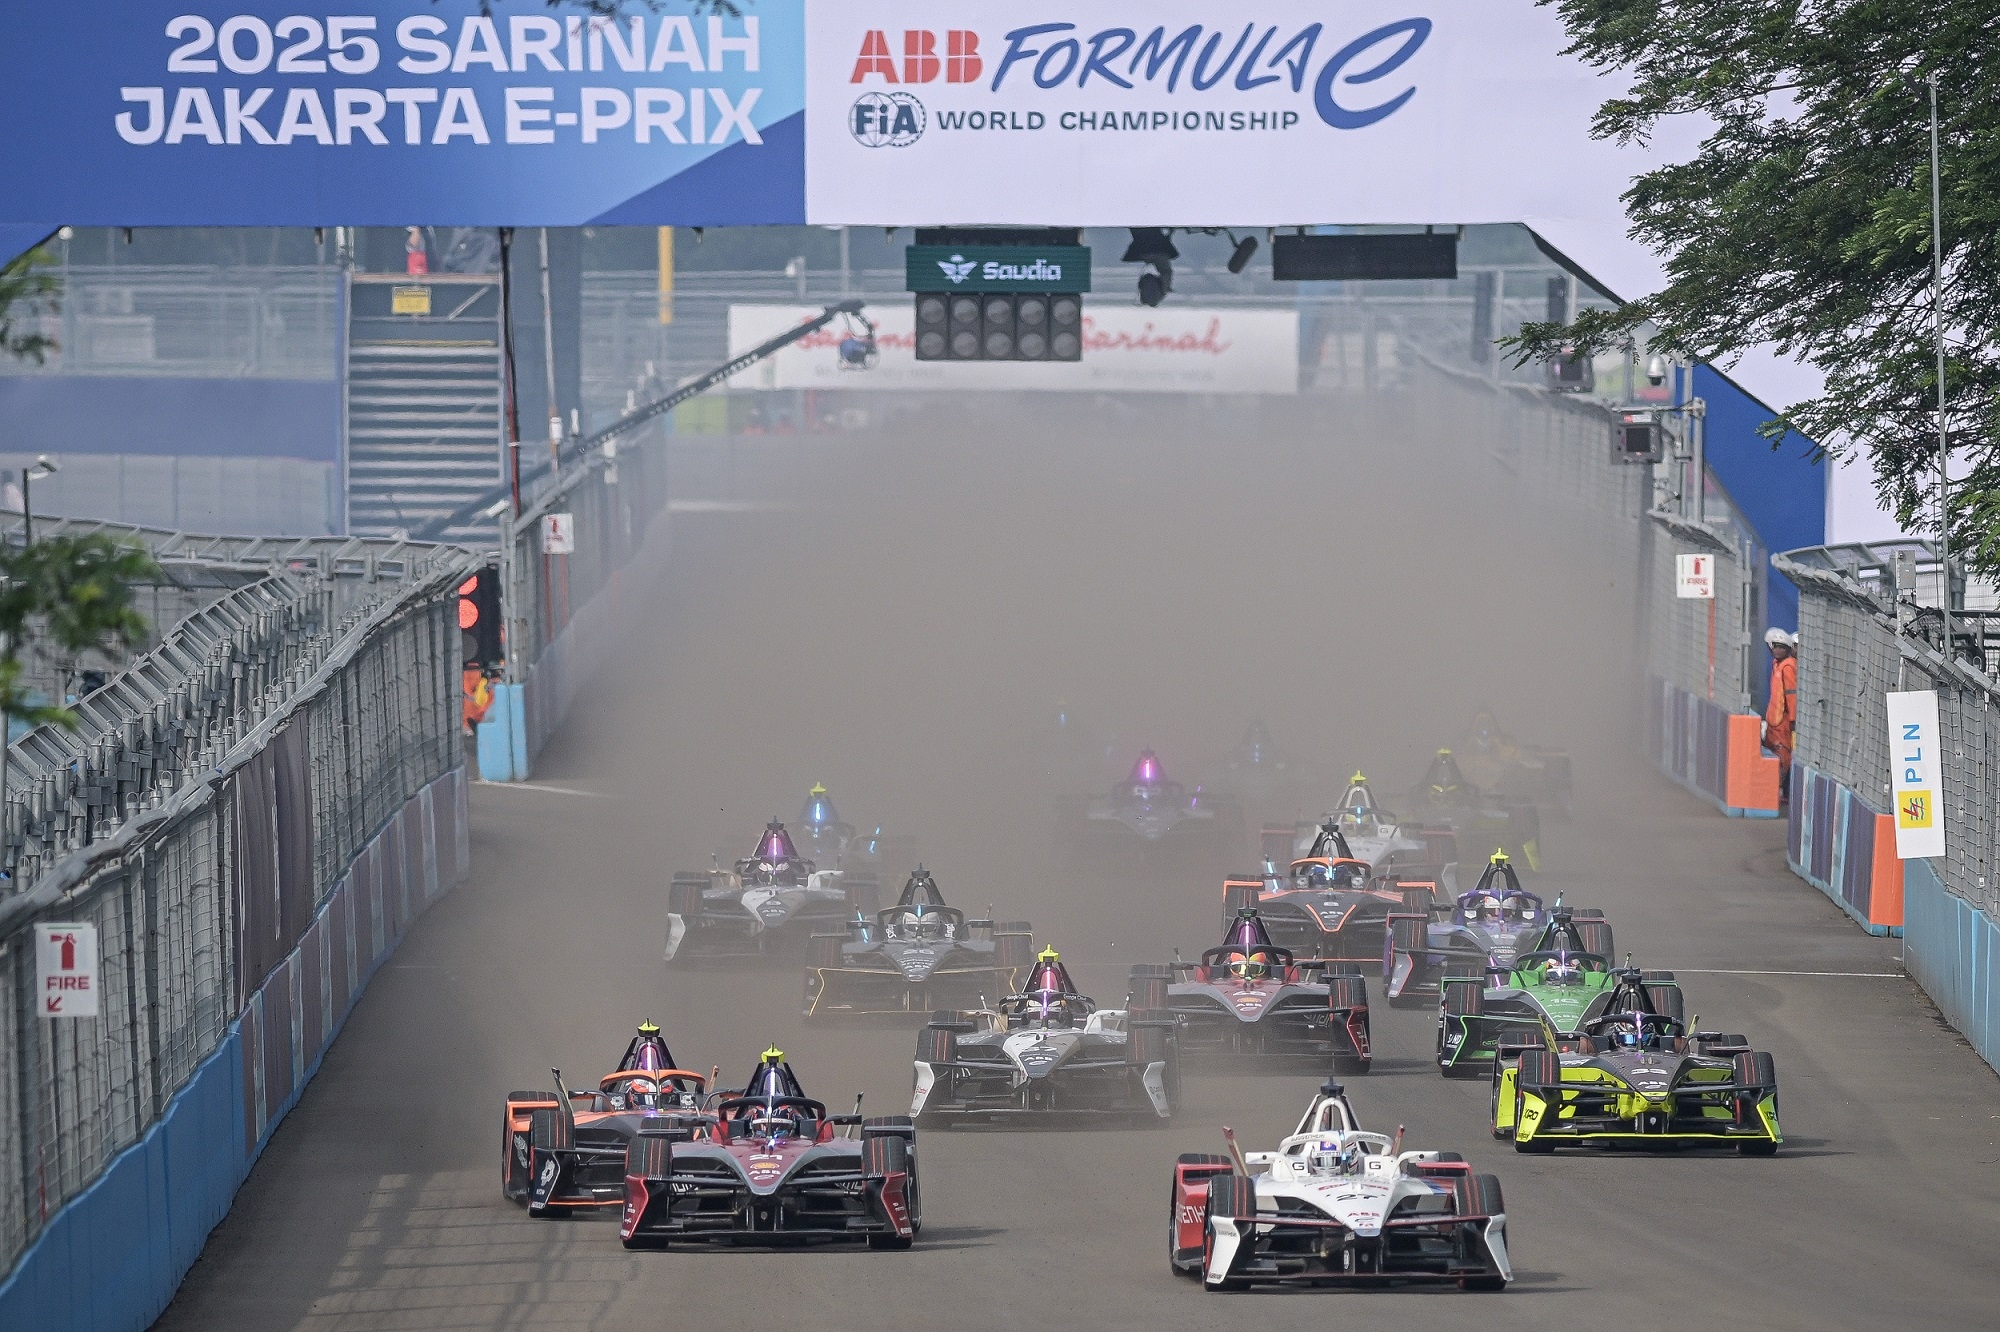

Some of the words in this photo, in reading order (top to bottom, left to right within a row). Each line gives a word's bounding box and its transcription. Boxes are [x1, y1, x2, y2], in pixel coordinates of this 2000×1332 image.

[167, 15, 380, 74] 2025
[398, 15, 760, 74] SARINAH
[850, 29, 983, 84] ABB
[990, 21, 1323, 94] FORMULA
[116, 87, 490, 145] JAKARTA
[505, 87, 763, 145] E-PRIX
[937, 110, 1045, 131] WORLD
[1060, 111, 1300, 131] CHAMPIONSHIP
[982, 258, 1062, 281] Saudia
[1902, 723, 1921, 784] PLN
[46, 976, 90, 990] FIRE
[1291, 1161, 1305, 1171] G
[1368, 1160, 1382, 1170] G
